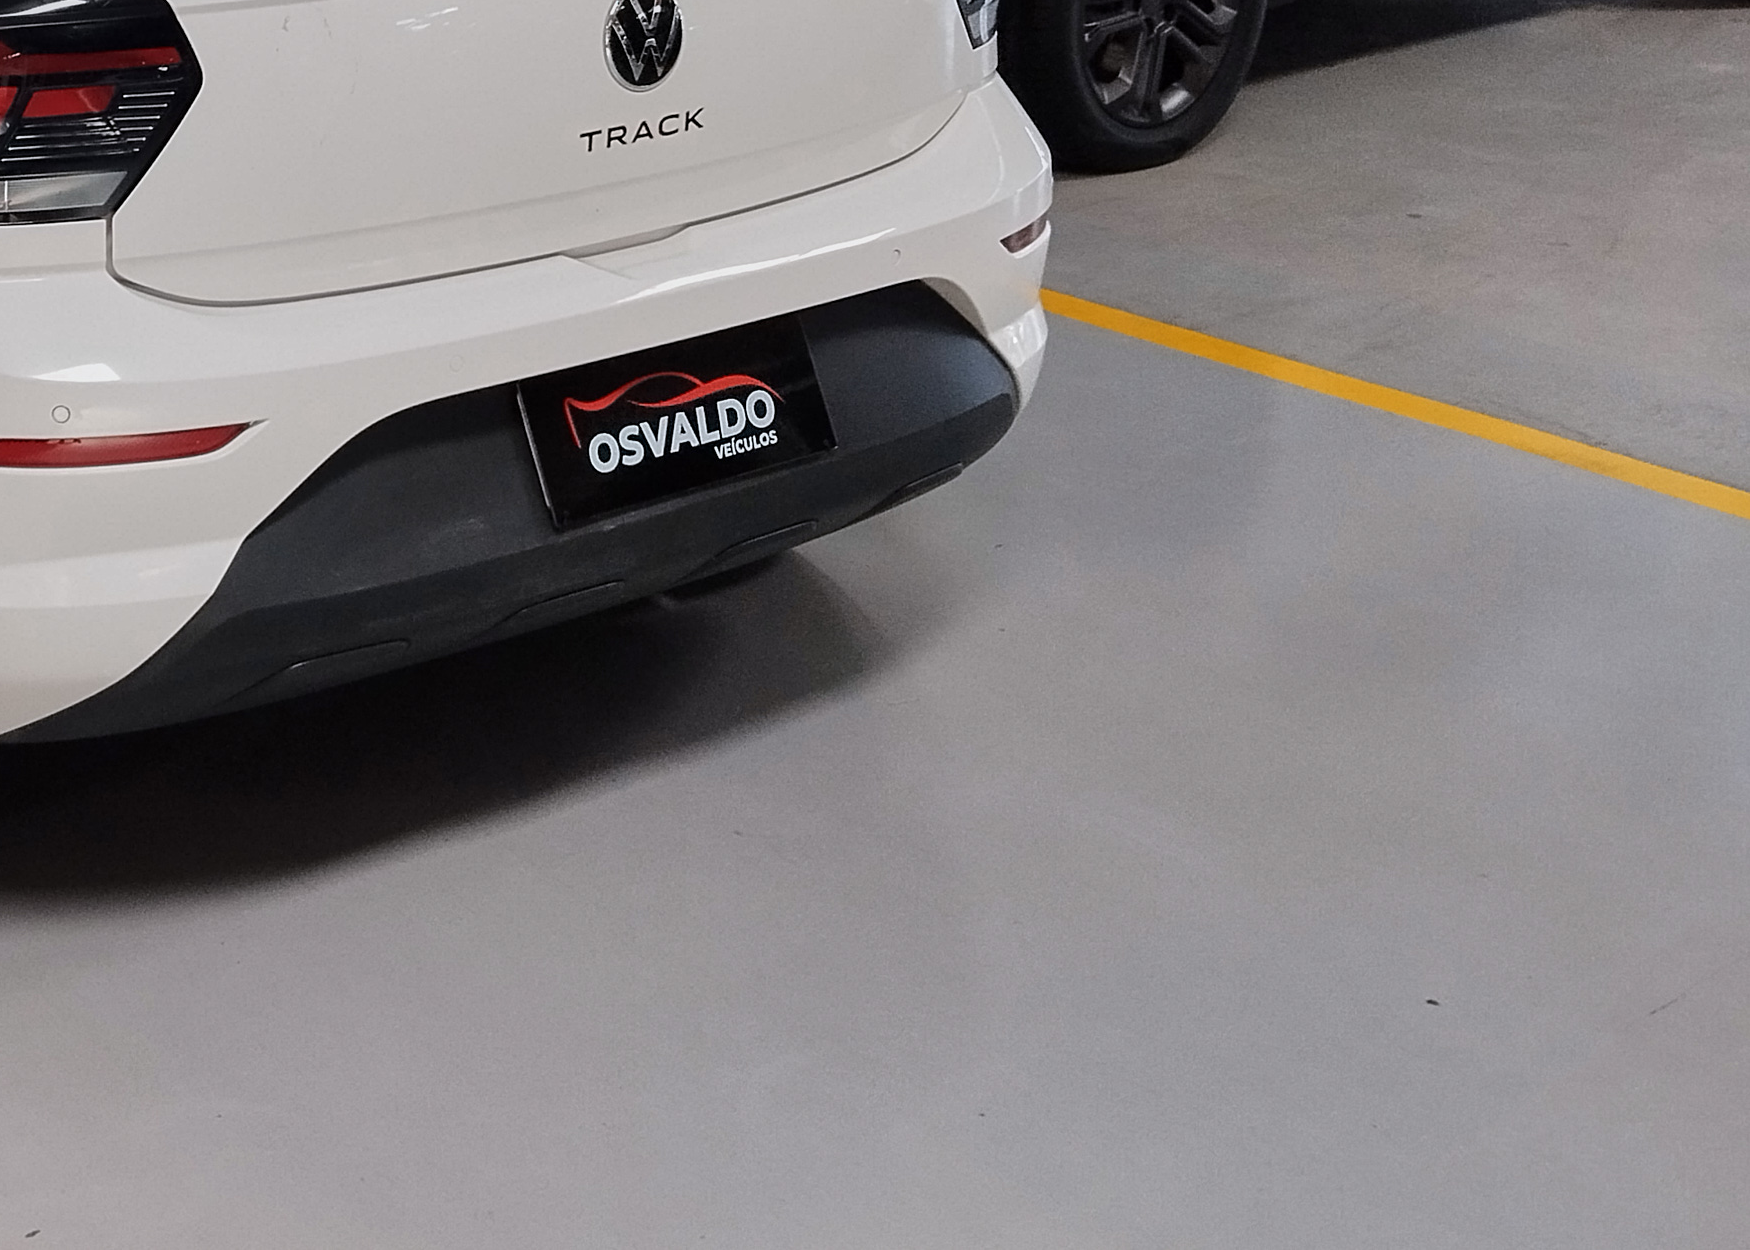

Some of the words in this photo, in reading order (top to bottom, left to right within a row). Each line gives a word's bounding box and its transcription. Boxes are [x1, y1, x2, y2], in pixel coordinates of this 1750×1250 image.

[580, 107, 705, 152] TRACK
[589, 390, 775, 473] OSVALDO
[714, 430, 778, 459] VEÍCULOS
